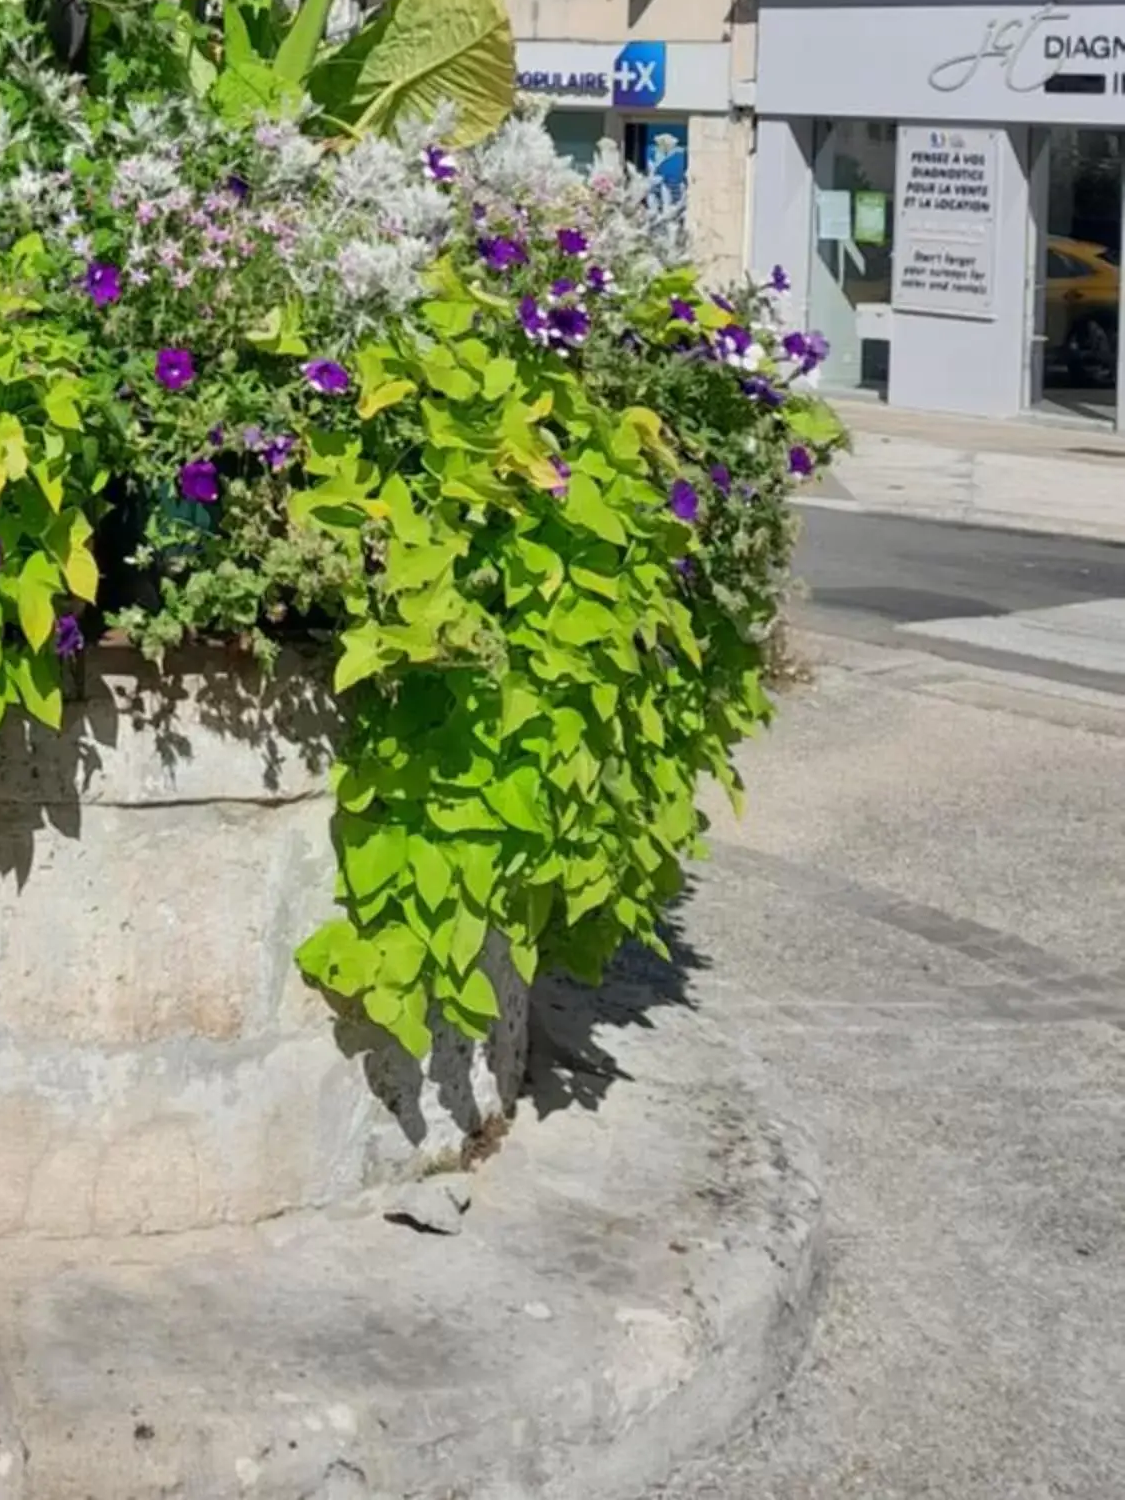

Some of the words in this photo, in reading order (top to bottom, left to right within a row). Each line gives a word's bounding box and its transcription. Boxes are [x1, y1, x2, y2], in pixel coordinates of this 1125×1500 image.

[907, 181, 935, 193] POUR
[938, 183, 951, 194] LA
[955, 185, 987, 197] VENTE
[904, 197, 916, 207] ET
[918, 198, 931, 208] LA
[935, 199, 990, 212] LOCATION
